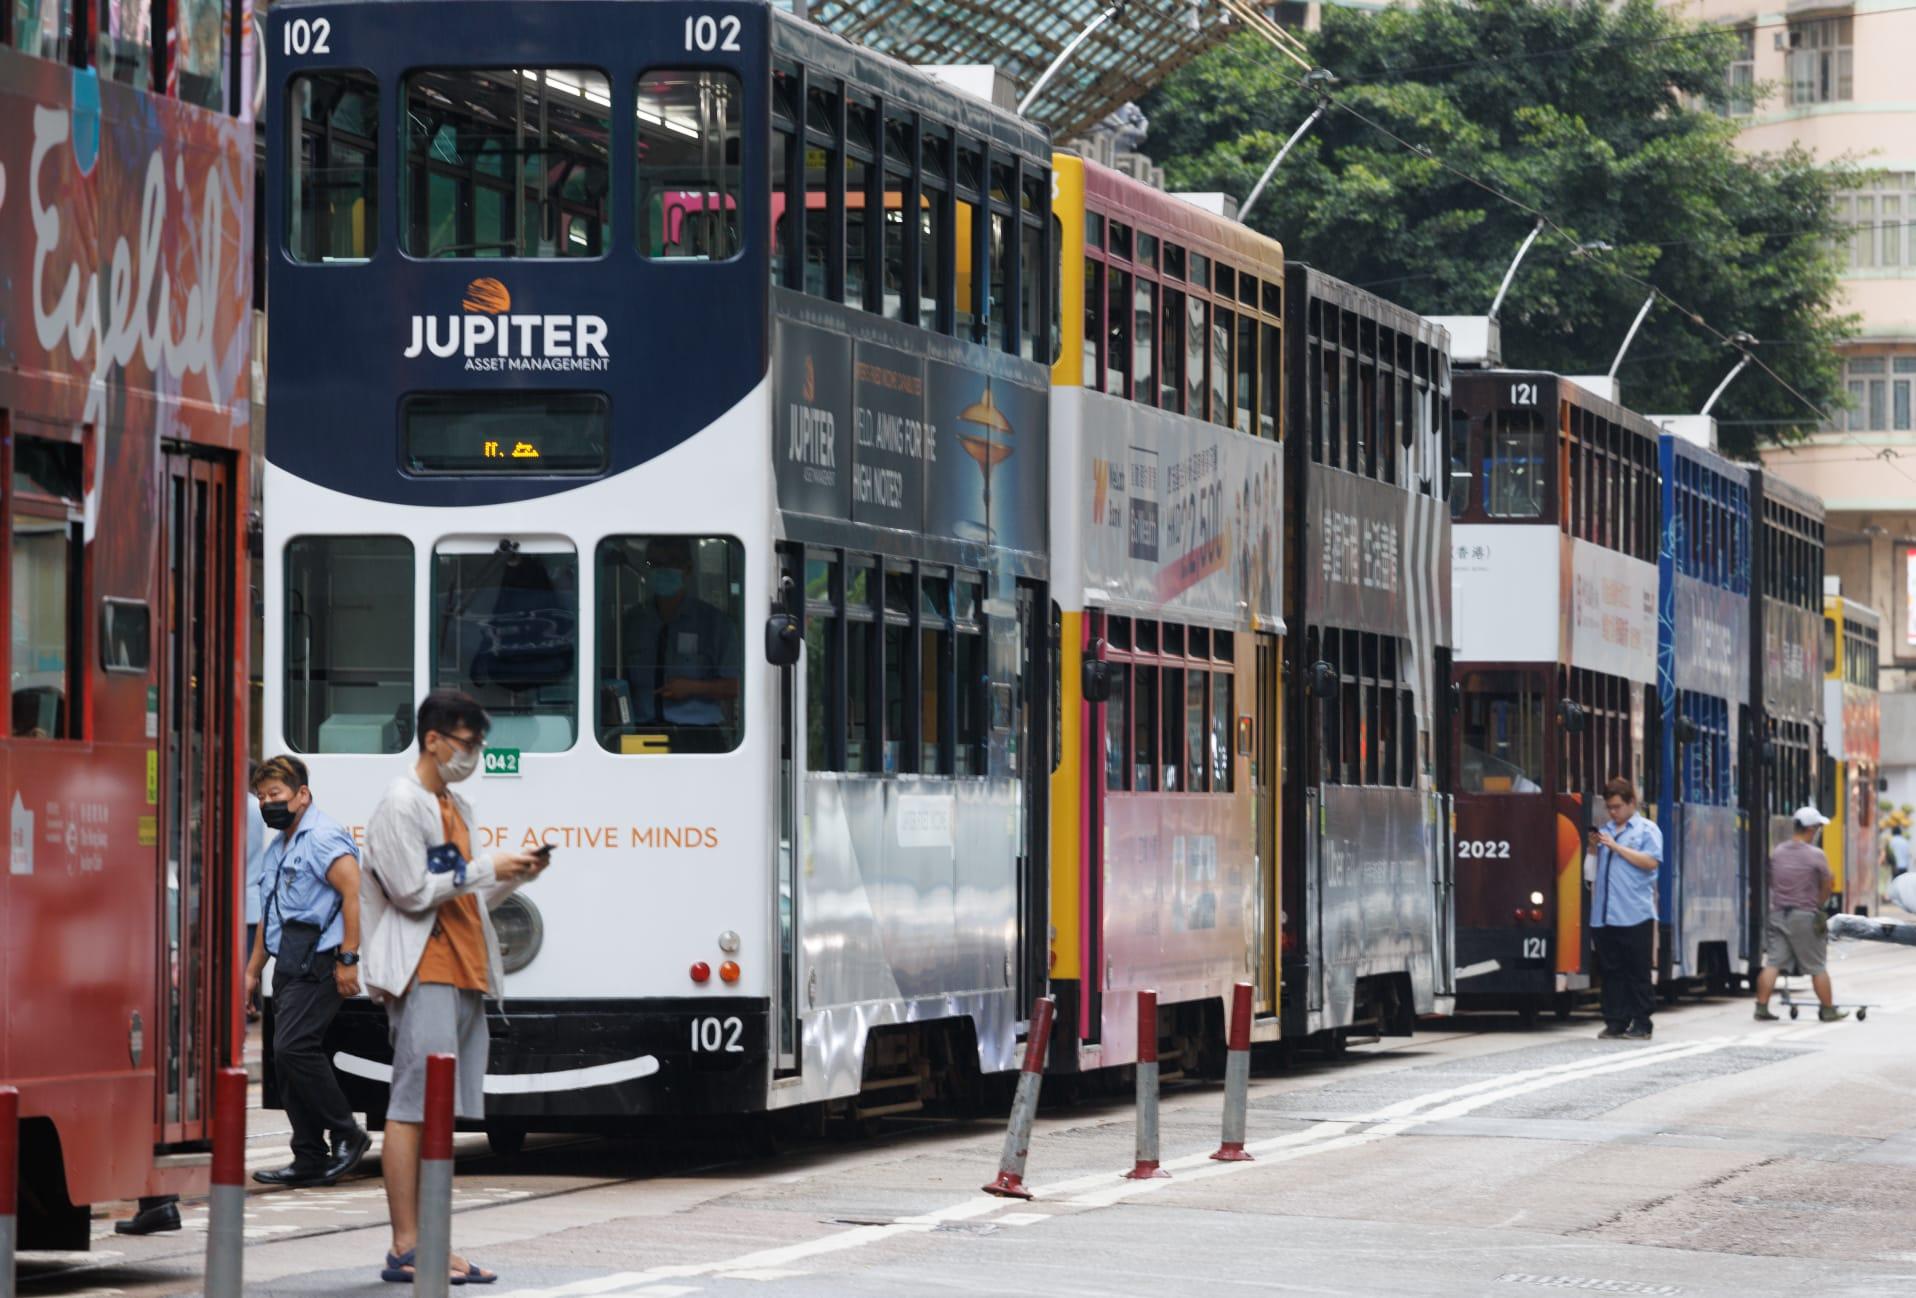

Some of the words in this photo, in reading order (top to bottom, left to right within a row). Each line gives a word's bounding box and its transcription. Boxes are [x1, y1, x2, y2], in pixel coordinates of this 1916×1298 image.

[284, 17, 331, 56] 102
[685, 15, 741, 52] 102
[403, 314, 610, 358] JUPITER
[464, 358, 507, 371] ASSET
[508, 358, 610, 371] MANAGEMENT
[1511, 384, 1538, 405] 121
[789, 403, 836, 468] JUPITER
[905, 418, 922, 459] FOR
[485, 753, 517, 771] 042
[520, 826, 618, 848] ACTIVE
[631, 827, 719, 848] MINDS
[1458, 840, 1510, 859] 2022
[1523, 937, 1546, 959] 121
[691, 1016, 744, 1052] 102
